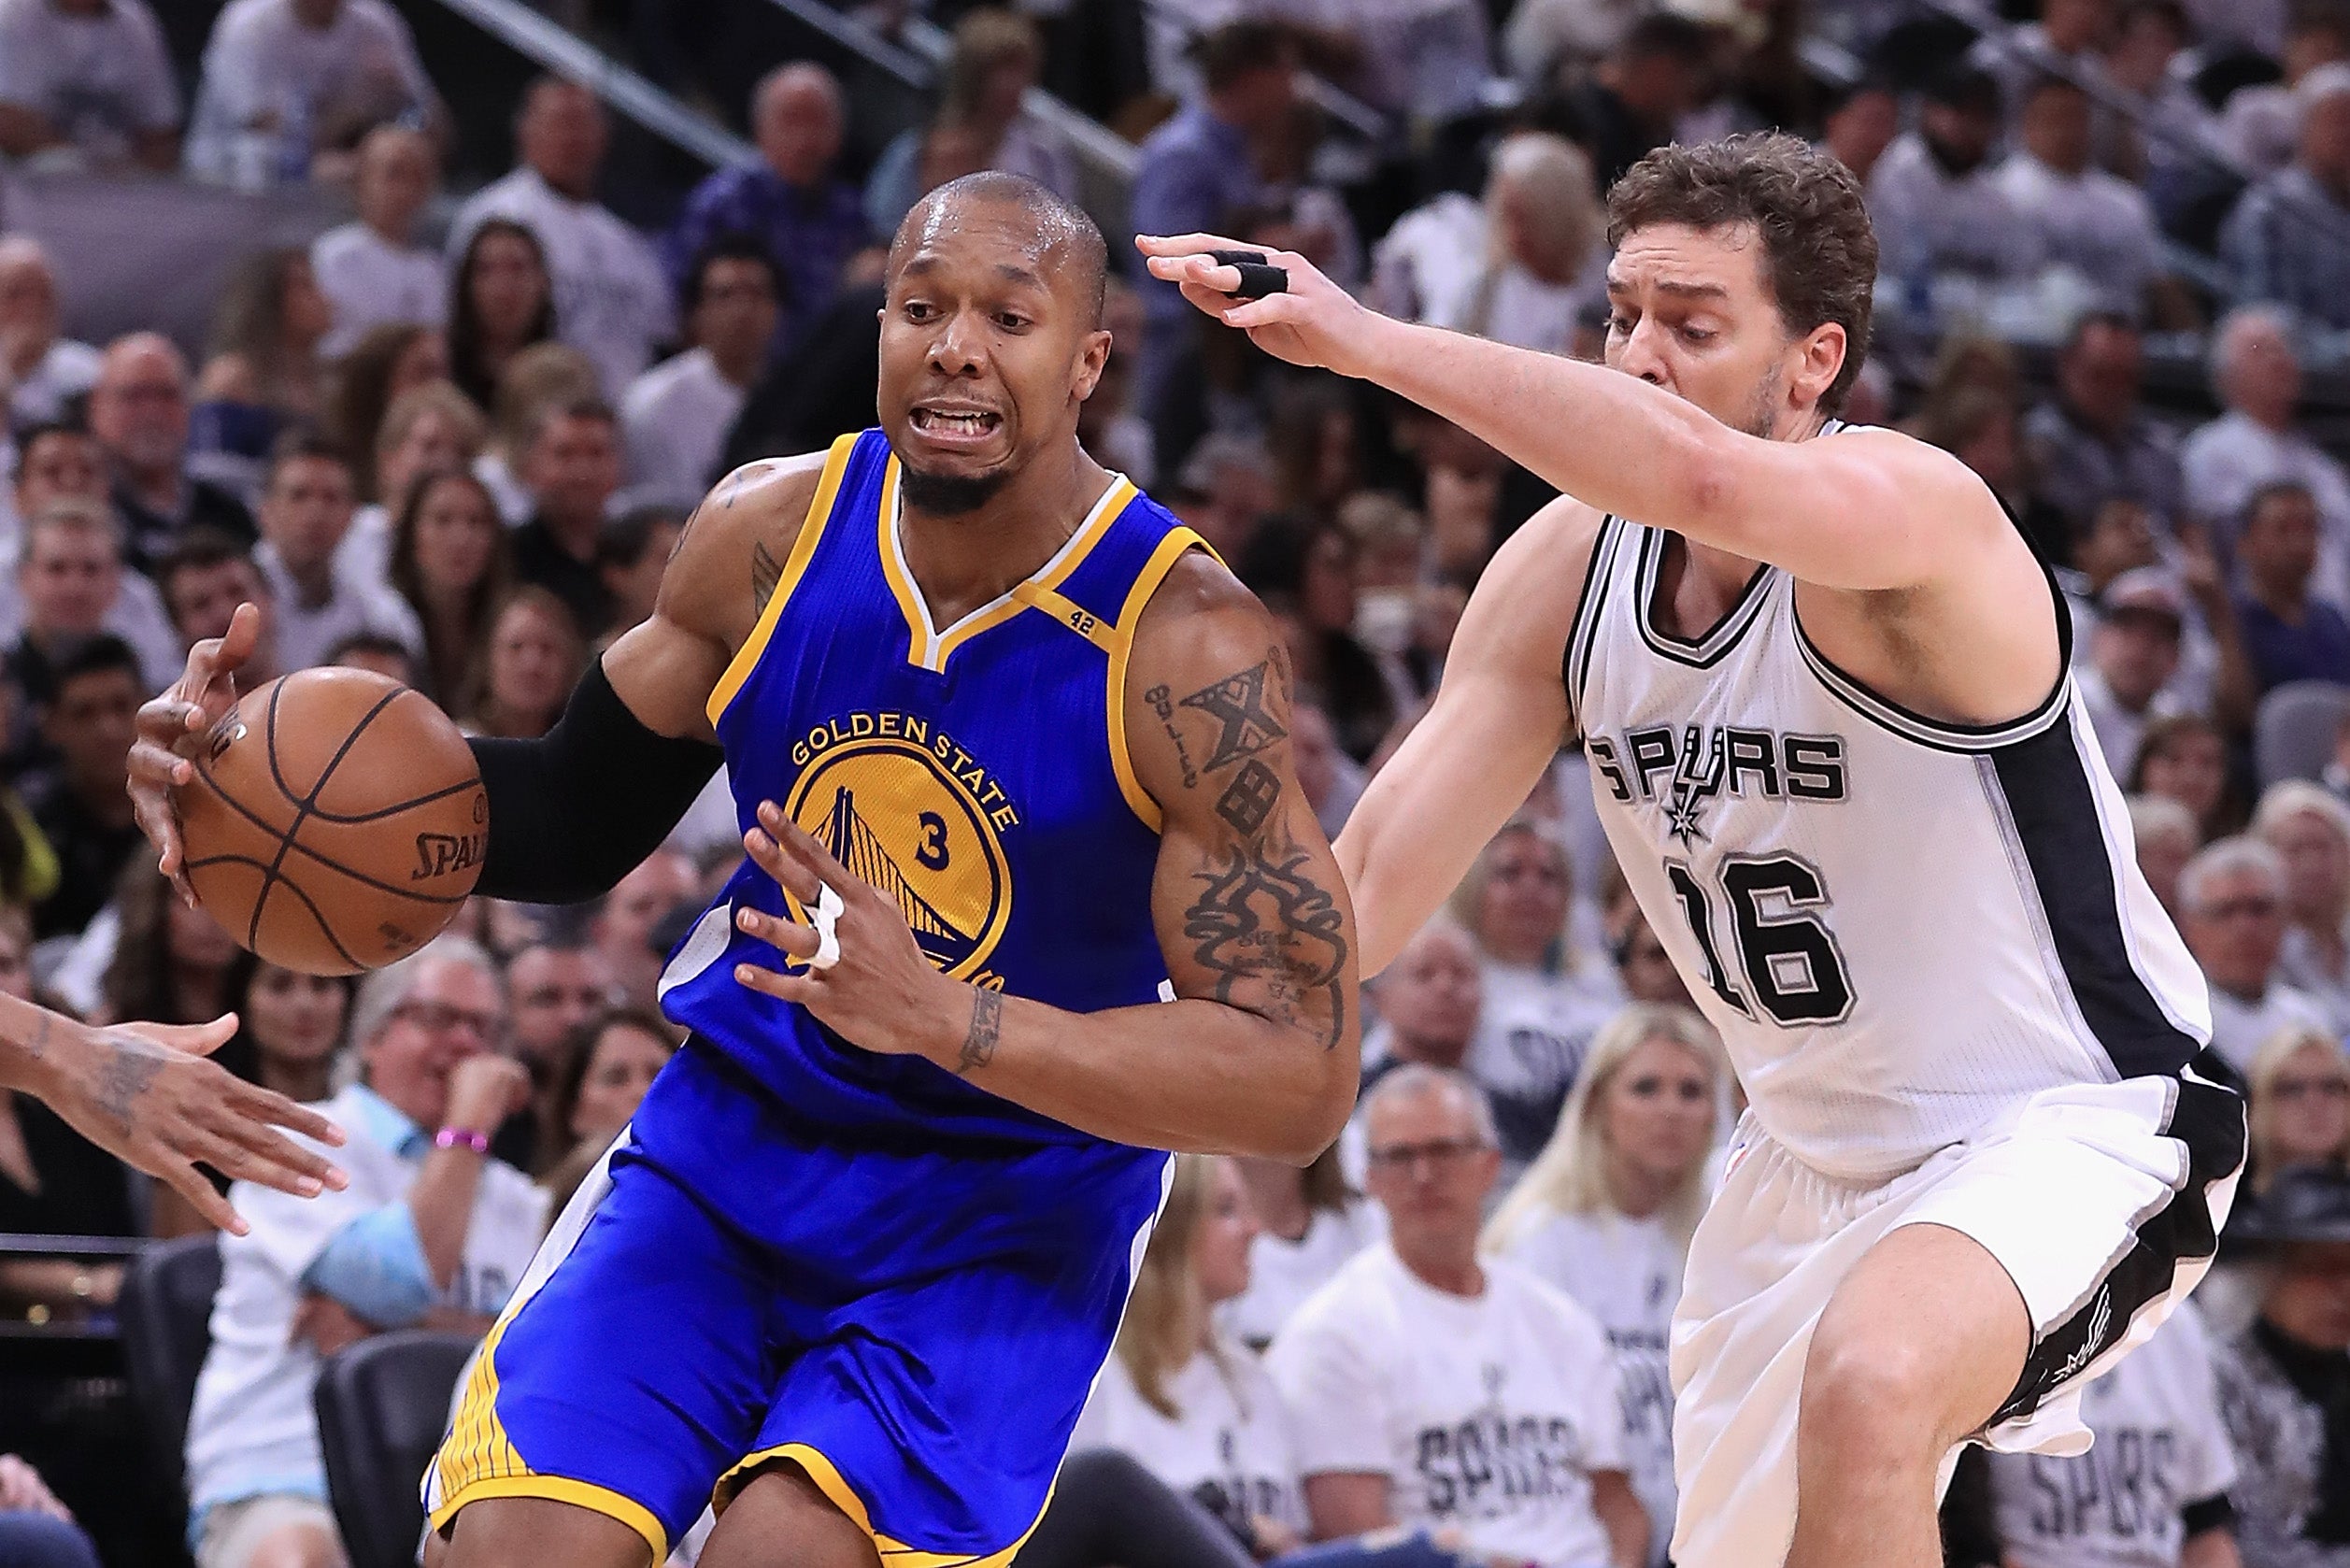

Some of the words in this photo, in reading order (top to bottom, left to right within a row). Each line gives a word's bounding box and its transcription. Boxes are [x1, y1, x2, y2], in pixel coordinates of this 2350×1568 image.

[1070, 610, 1095, 635] 42
[792, 712, 928, 766] GOLDEN
[933, 734, 1019, 833] STATE
[1588, 724, 1851, 804] SPURS
[915, 810, 949, 871] 3
[1663, 850, 1859, 1029] 16
